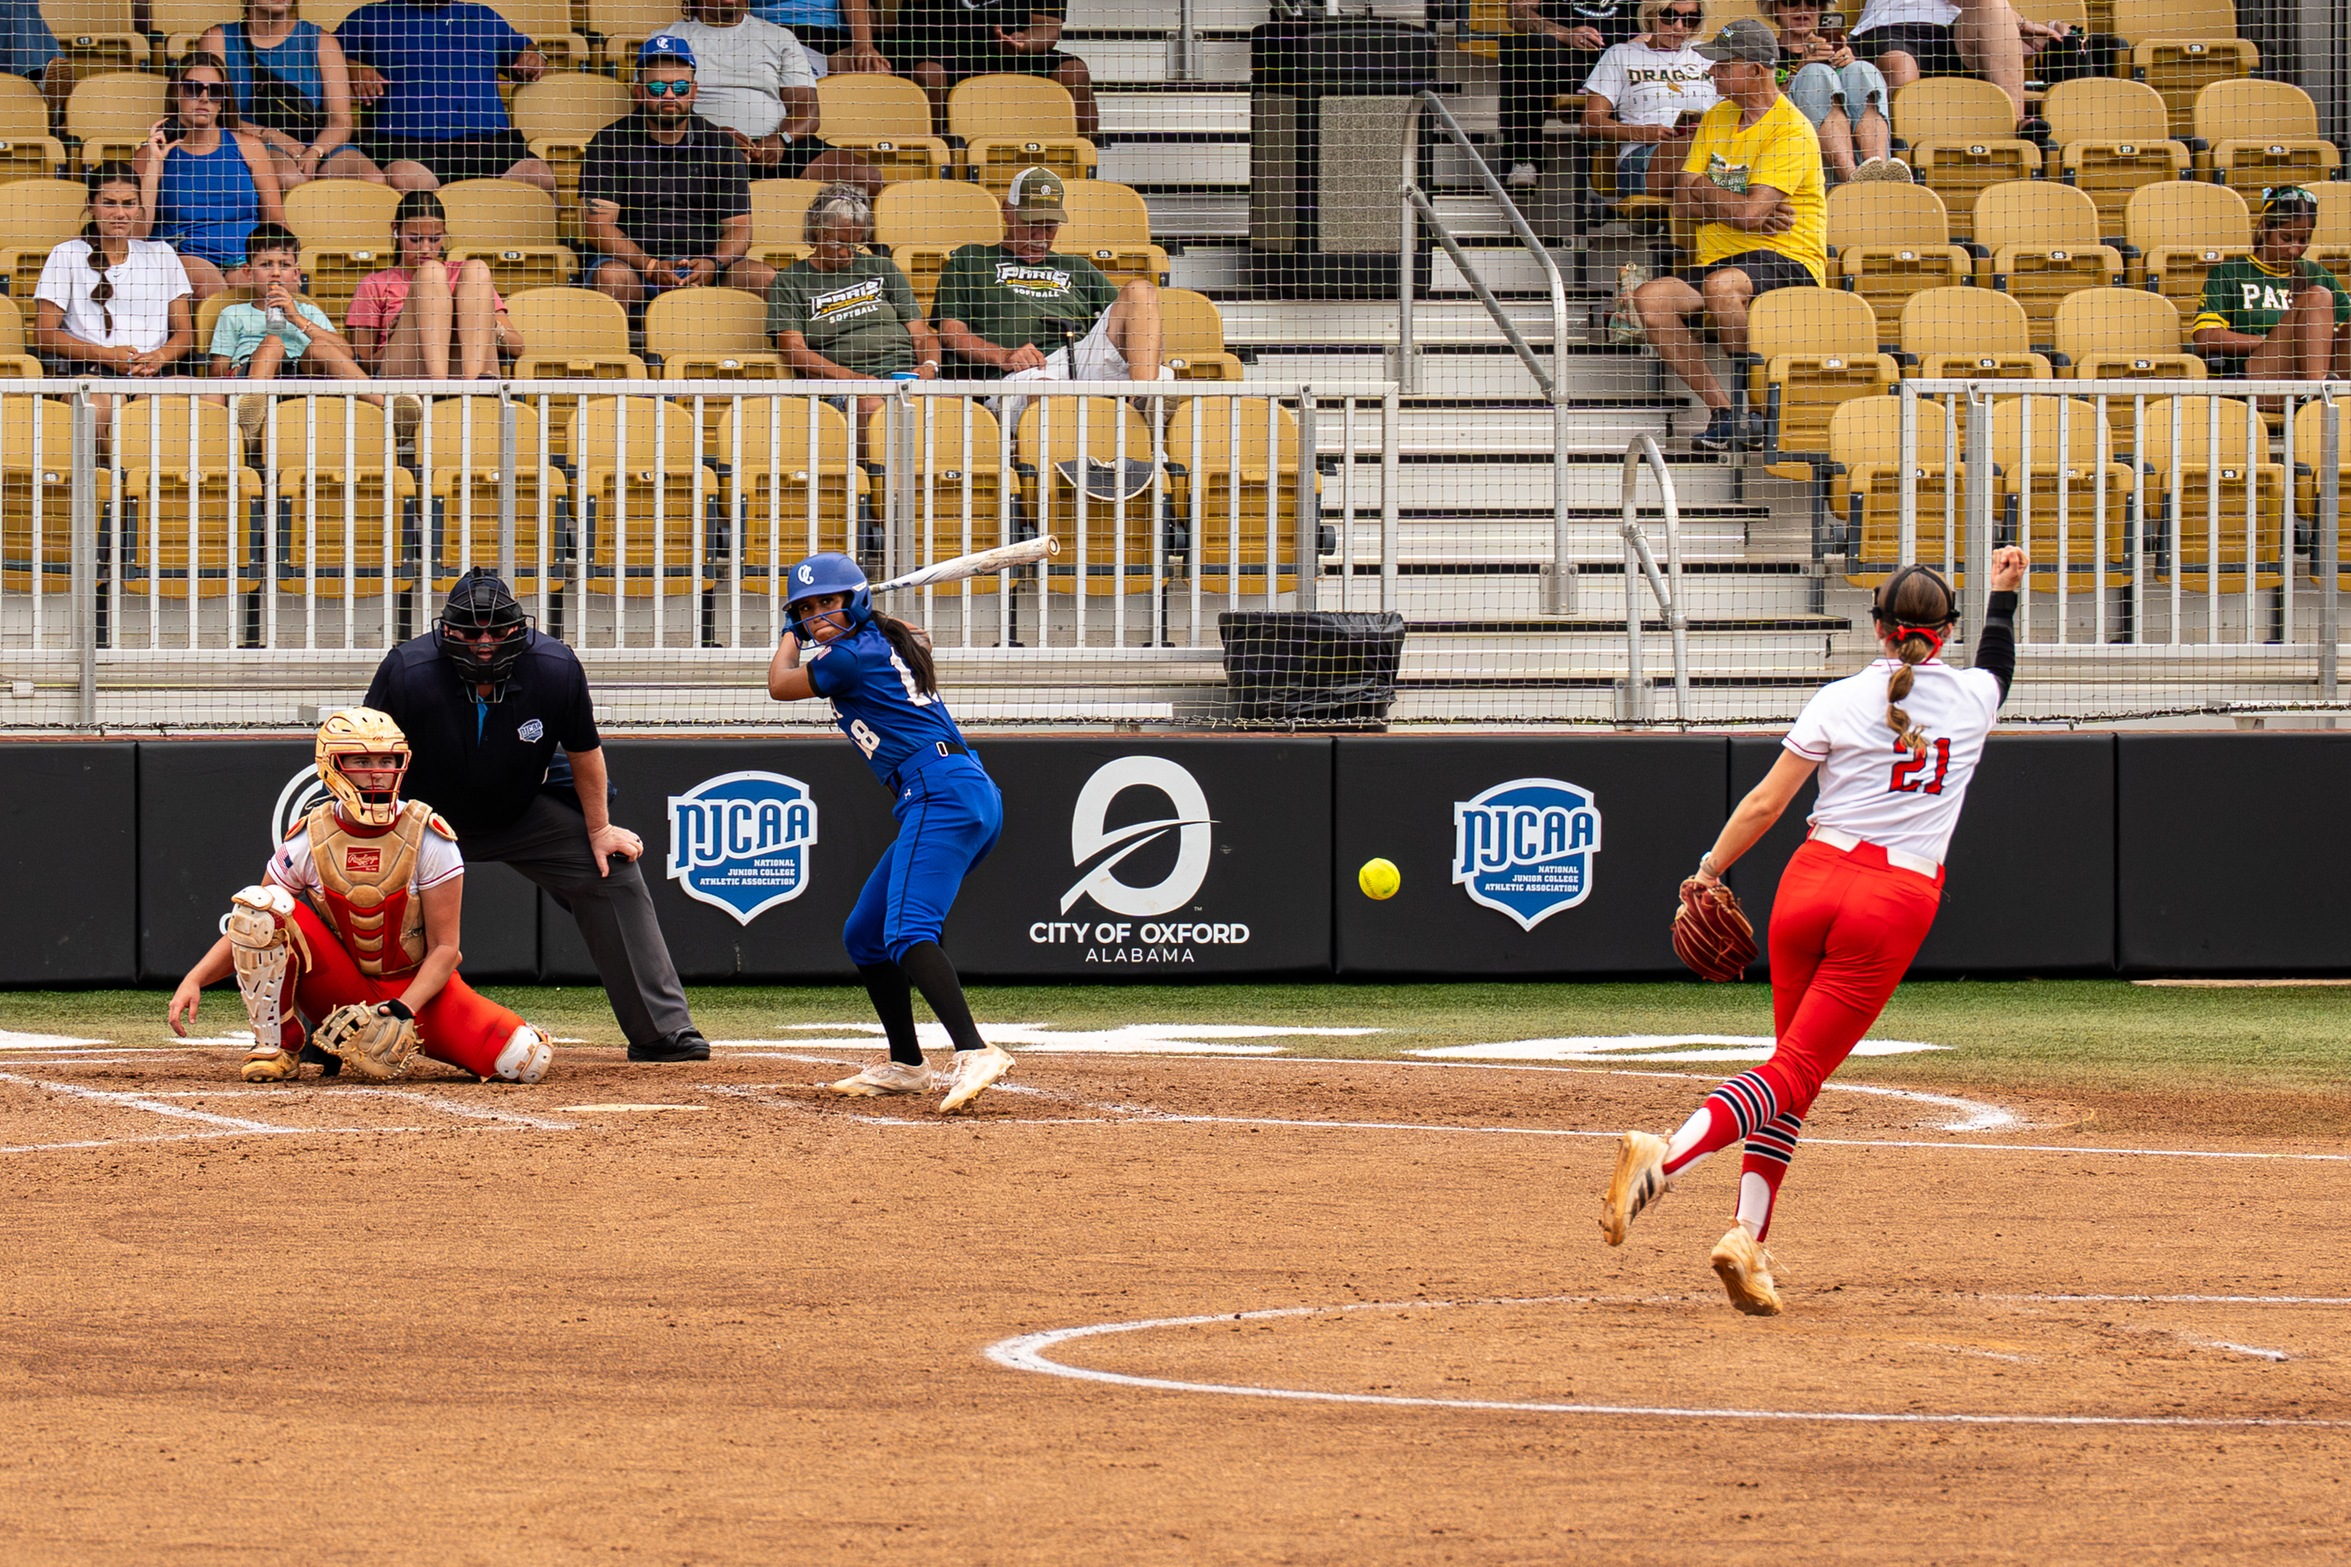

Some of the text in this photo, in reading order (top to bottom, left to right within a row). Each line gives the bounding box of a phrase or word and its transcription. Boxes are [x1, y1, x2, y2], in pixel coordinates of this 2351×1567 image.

[1001, 266, 1067, 288] PARIS
[816, 281, 879, 309] PARIS
[1013, 287, 1060, 298] SOFTBALL
[828, 305, 879, 324] SOFTBALL
[890, 646, 940, 707] 1
[1888, 734, 1951, 796] 21
[675, 803, 810, 870] NJCAA
[1460, 810, 1594, 875] NJCAA
[753, 859, 796, 867] NATIONAL
[1538, 865, 1579, 874] NATIONAL
[699, 878, 796, 886] ATHLETIC ASSOCIATION
[1484, 883, 1579, 892] ATHLETIC ASSOCIATION
[1512, 874, 1579, 883] JUNIOR COLLEGE
[1029, 922, 1250, 944] CITY OF OXFORD
[1085, 948, 1195, 963] ALABAMA
